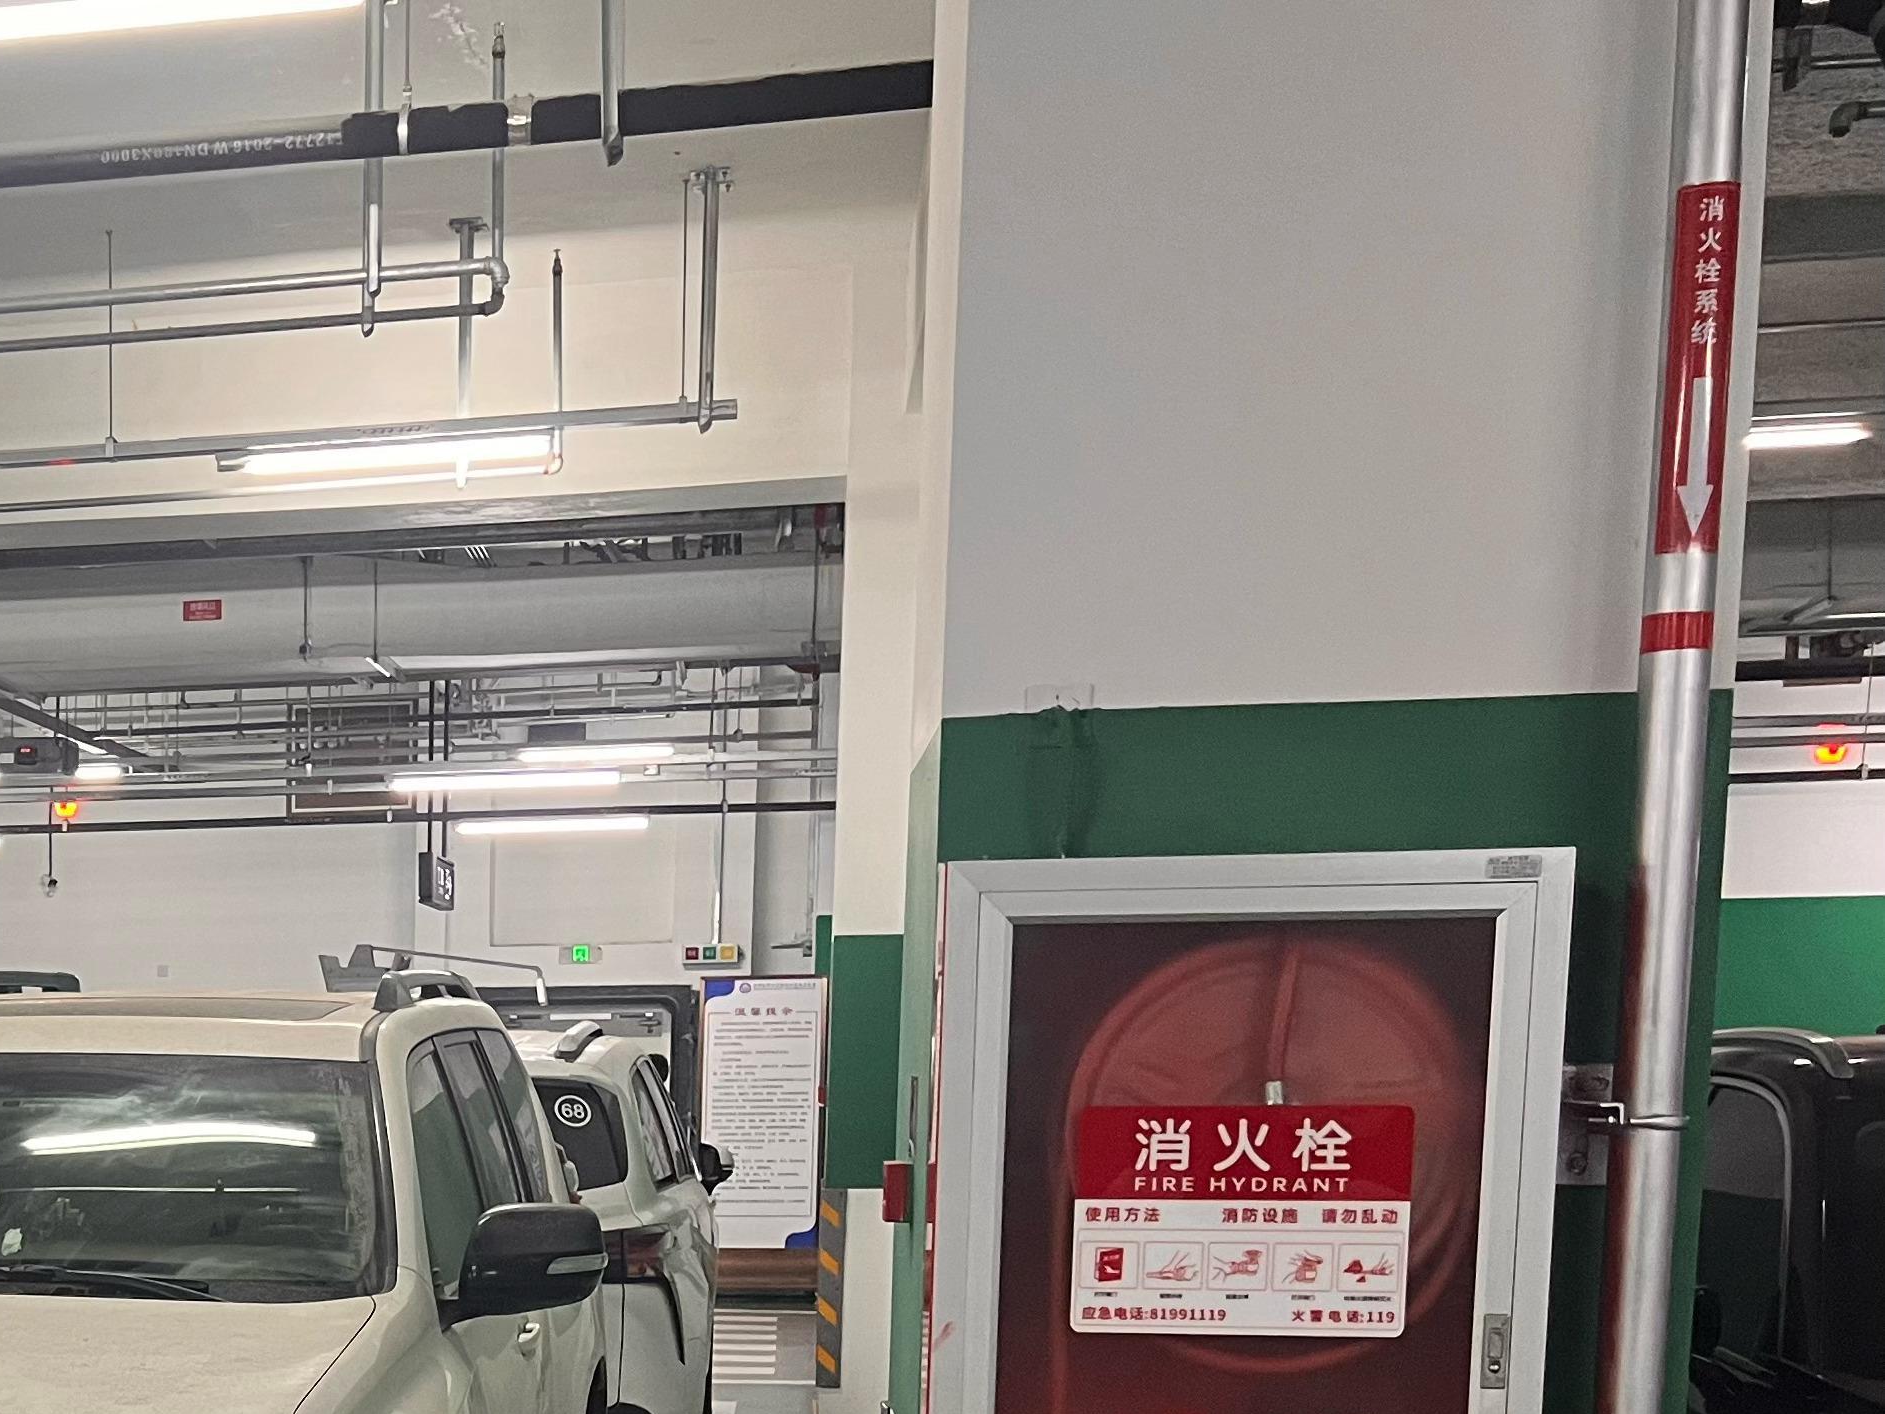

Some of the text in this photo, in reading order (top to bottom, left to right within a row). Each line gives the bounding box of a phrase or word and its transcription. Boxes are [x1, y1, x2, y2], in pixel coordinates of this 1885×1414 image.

[1690, 195, 1725, 345] 消火栓系统
[561, 1103, 585, 1119] 68
[1134, 1117, 1353, 1173] 消火栓
[1134, 1177, 1349, 1193] FIRE HYDRANT
[1085, 1206, 1399, 1225] 使用方法 消防设施 请勿乱动
